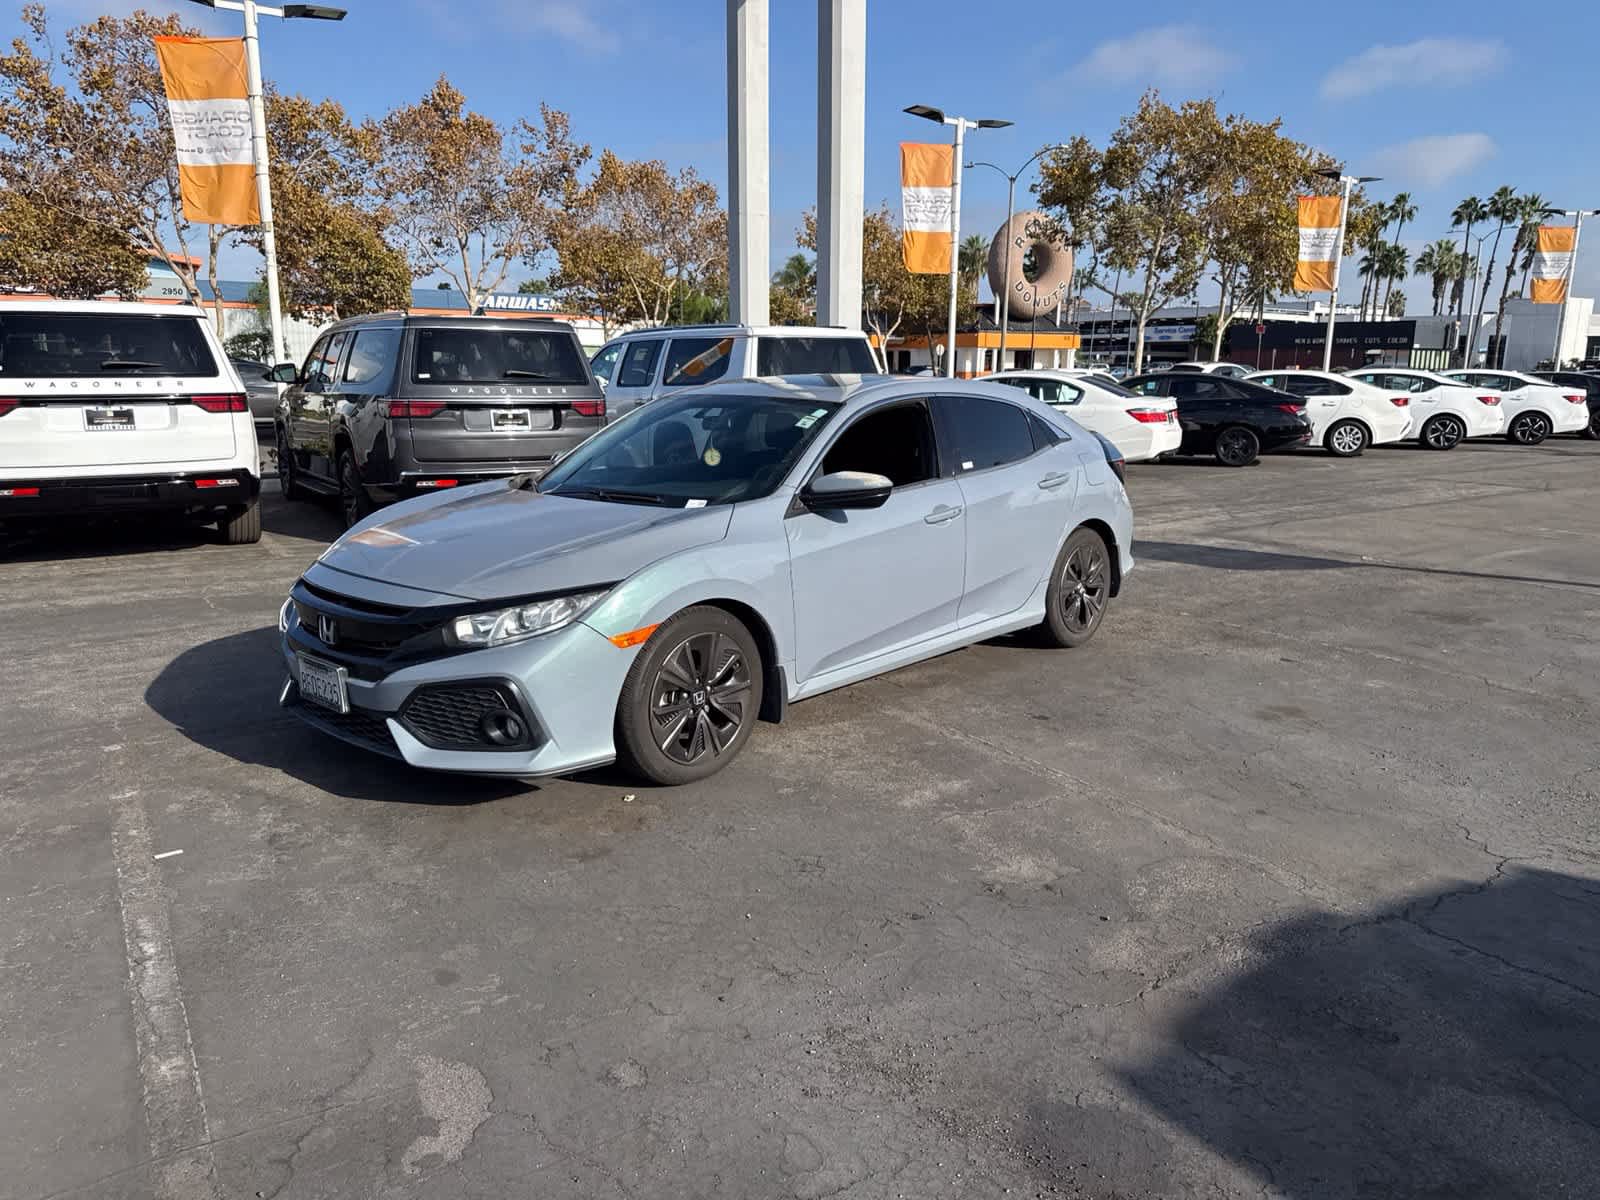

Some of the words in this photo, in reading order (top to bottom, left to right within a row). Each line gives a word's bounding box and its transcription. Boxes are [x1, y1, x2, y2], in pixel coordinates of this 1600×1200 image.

[161, 287, 184, 296] 2950
[1015, 281, 1066, 308] DONUTS
[24, 381, 184, 389] WAGONEER
[450, 386, 568, 394] WAGONEER
